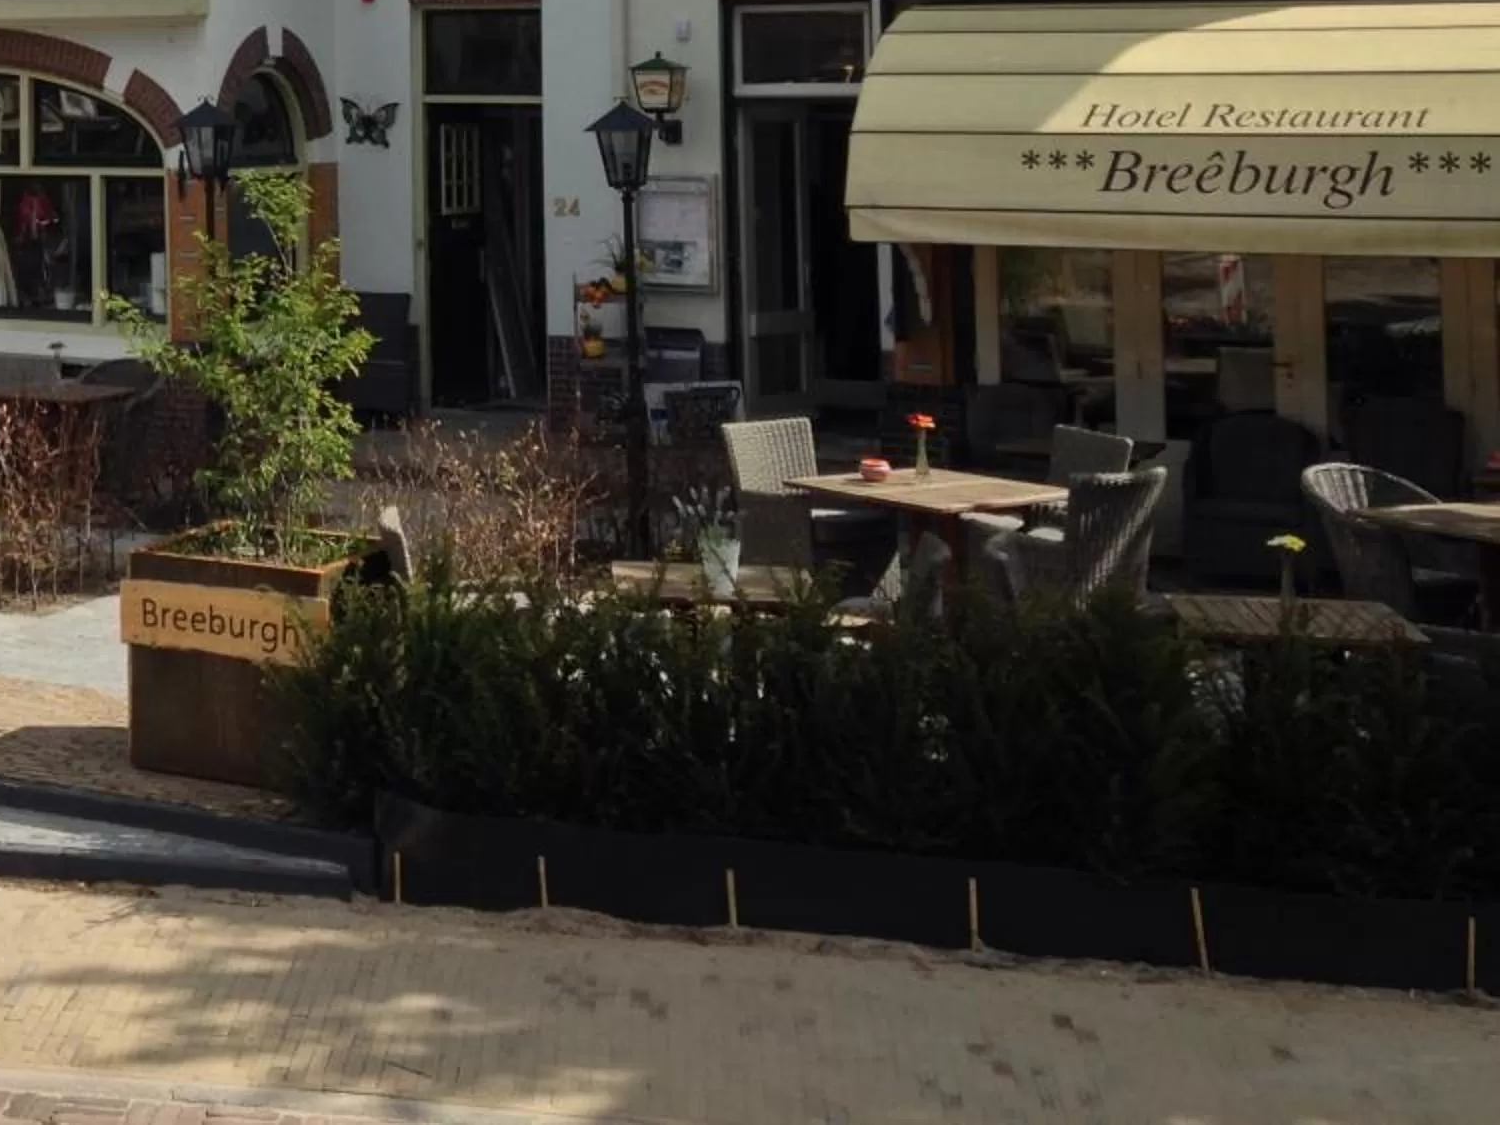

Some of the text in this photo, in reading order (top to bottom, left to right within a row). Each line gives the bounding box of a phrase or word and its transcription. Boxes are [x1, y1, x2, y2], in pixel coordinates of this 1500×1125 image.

[1081, 102, 1430, 129] Hotel Restaurant
[553, 196, 581, 218] 24
[140, 598, 300, 653] Breeburgh
